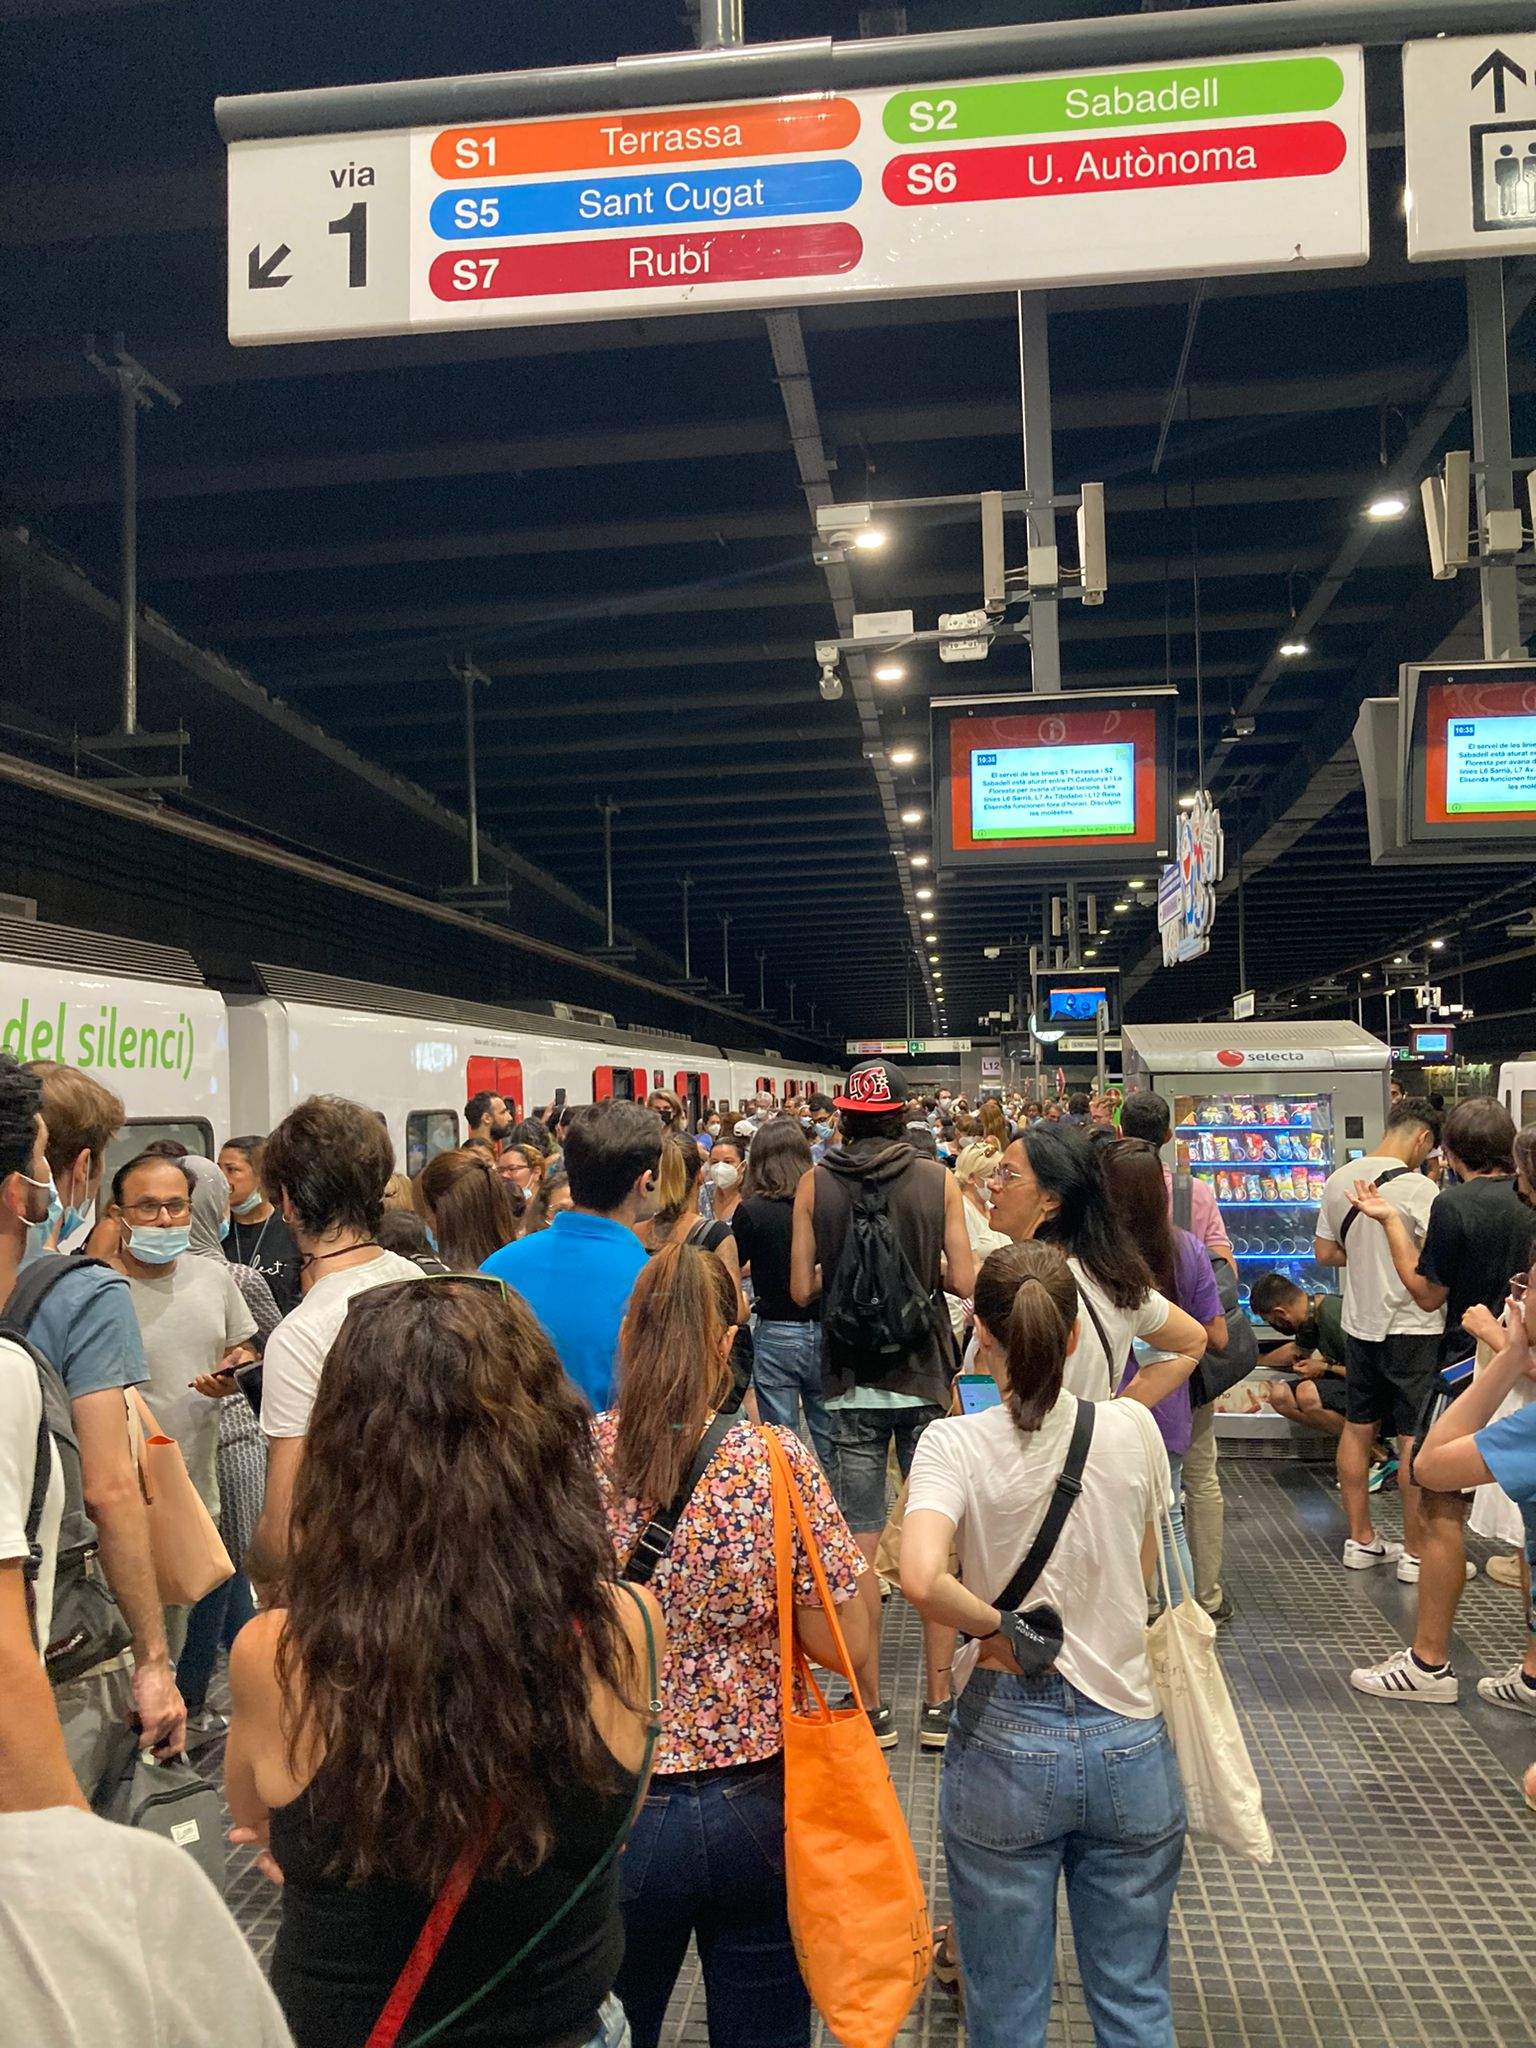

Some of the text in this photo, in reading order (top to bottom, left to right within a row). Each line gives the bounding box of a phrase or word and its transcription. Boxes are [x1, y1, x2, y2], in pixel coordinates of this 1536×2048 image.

[909, 79, 1218, 133] S2 Sabadell
[455, 121, 743, 169] S1 Terrassa
[907, 141, 1257, 195] S6 U. Autònoma
[329, 162, 375, 189] via
[455, 178, 764, 230] S5 Sant Cugat
[328, 202, 367, 288] 1
[452, 239, 712, 291] S7 Rubí
[3, 998, 194, 1081] del silenci)
[1247, 1051, 1304, 1062] selecta
[983, 1061, 1000, 1071] L12
